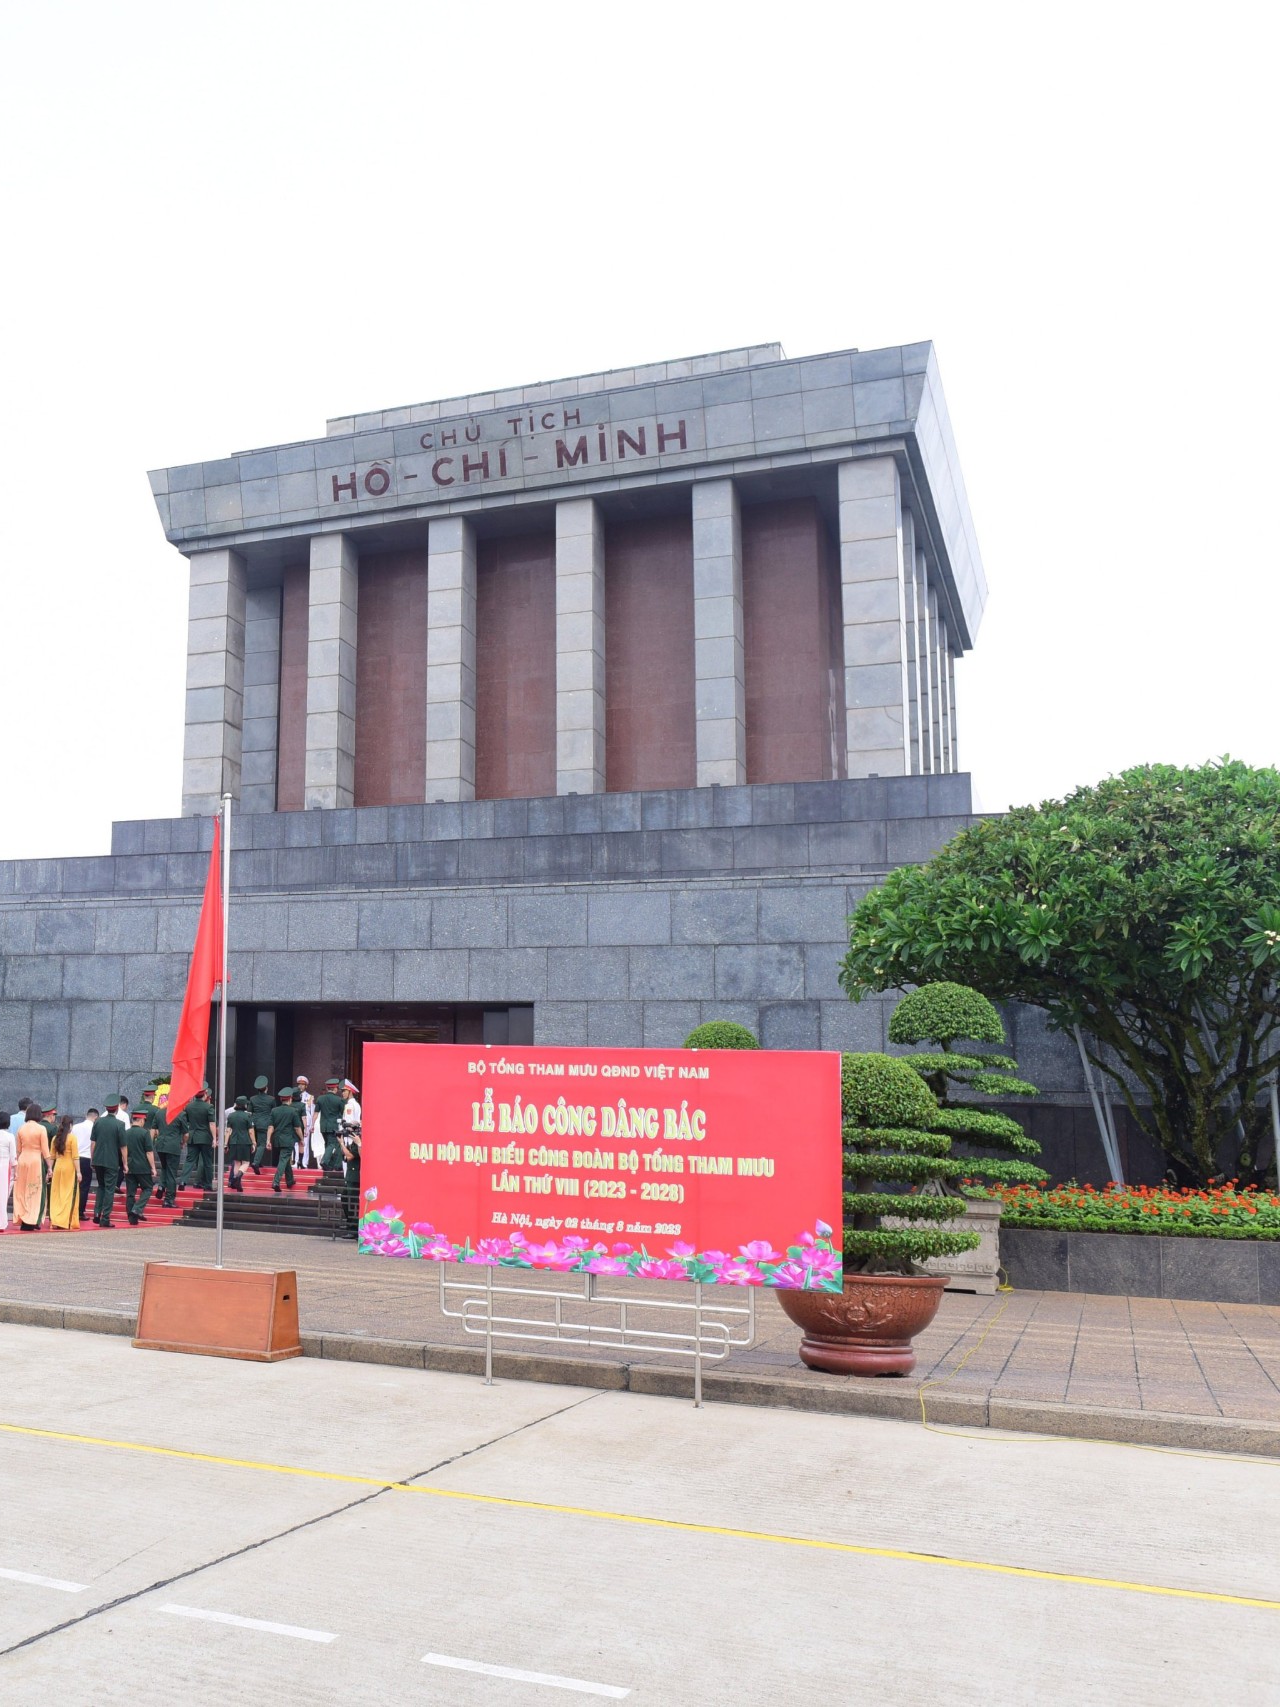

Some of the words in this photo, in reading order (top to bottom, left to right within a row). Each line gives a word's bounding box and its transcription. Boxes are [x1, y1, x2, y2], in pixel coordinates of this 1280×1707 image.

[420, 418, 481, 450] CHỦ
[432, 440, 510, 486] CHÍ
[467, 1059, 487, 1076] BỘ
[489, 1057, 525, 1075] TỔNG
[528, 1063, 565, 1076] THAM
[568, 1064, 597, 1077] MƯU
[600, 1064, 640, 1078] QĐND
[644, 1063, 675, 1080] VIỆT
[678, 1067, 710, 1079] NAM
[472, 1087, 495, 1132] LỄ
[498, 1094, 539, 1135] BÁO
[542, 1095, 597, 1137] CÔNG
[600, 1097, 659, 1139] DÂNG
[663, 1100, 707, 1141] BÁC
[409, 1142, 433, 1164] ĐẠI
[437, 1141, 461, 1165] HỘI
[463, 1145, 488, 1166] ĐẠI
[528, 1145, 569, 1168] CÔNG
[572, 1147, 614, 1170] ĐOÀN
[617, 1149, 639, 1175] BỘ
[642, 1147, 684, 1173] TỔNG
[687, 1155, 733, 1175] THAM
[737, 1156, 775, 1178] MƯU
[523, 1173, 553, 1195] THỨ
[555, 1177, 580, 1196] VIII
[583, 1179, 627, 1199] (2023
[640, 1182, 685, 1204] 2028)
[491, 1211, 508, 1224] Hà
[509, 1212, 533, 1228] Nội,
[535, 1216, 564, 1230] ngày
[580, 1217, 615, 1234] tháng
[625, 1221, 652, 1234] năm
